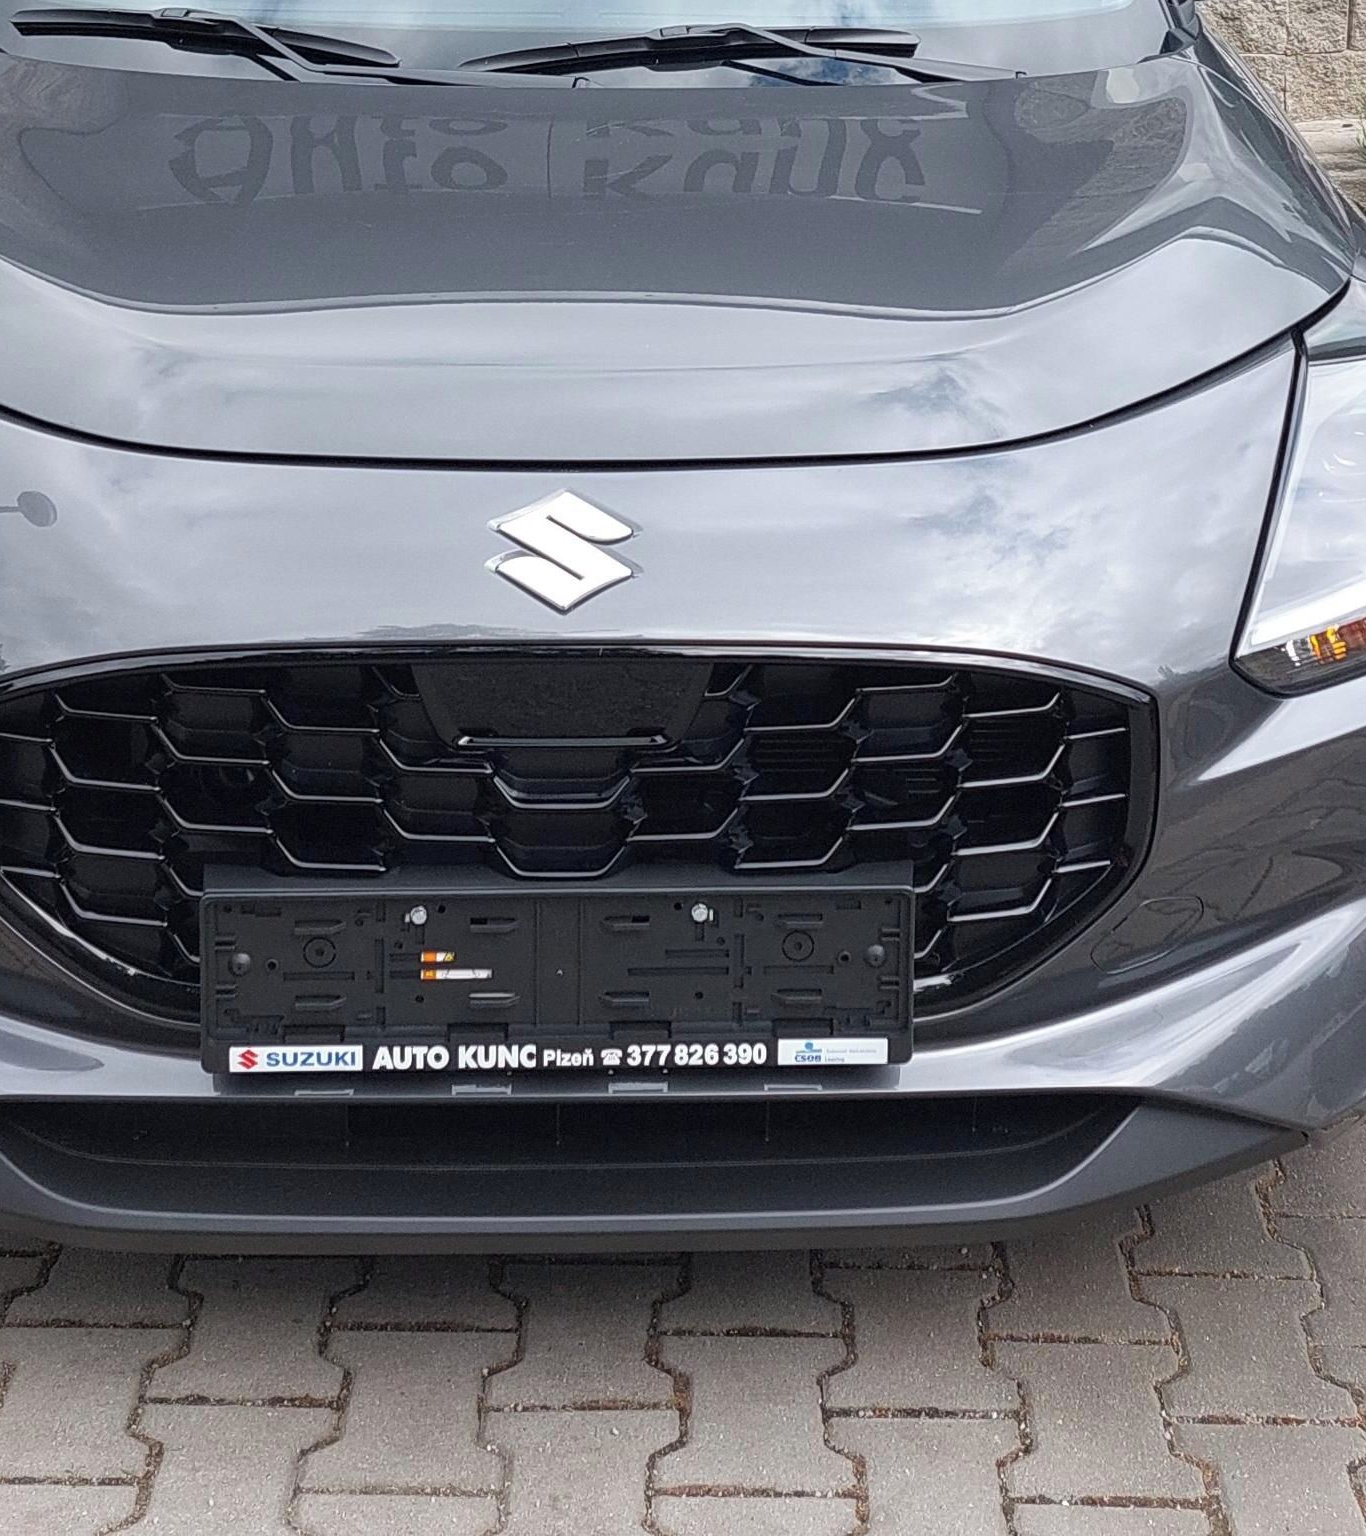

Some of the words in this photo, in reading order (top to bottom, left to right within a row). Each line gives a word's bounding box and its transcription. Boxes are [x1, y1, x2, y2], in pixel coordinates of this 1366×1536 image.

[265, 1050, 356, 1068] SUZUKI
[371, 1045, 450, 1070] AUTO
[457, 1044, 536, 1070] KUNC
[542, 1048, 595, 1067] Plzeň
[626, 1042, 672, 1066] 377
[673, 1042, 720, 1066] 826
[722, 1042, 768, 1065] 390
